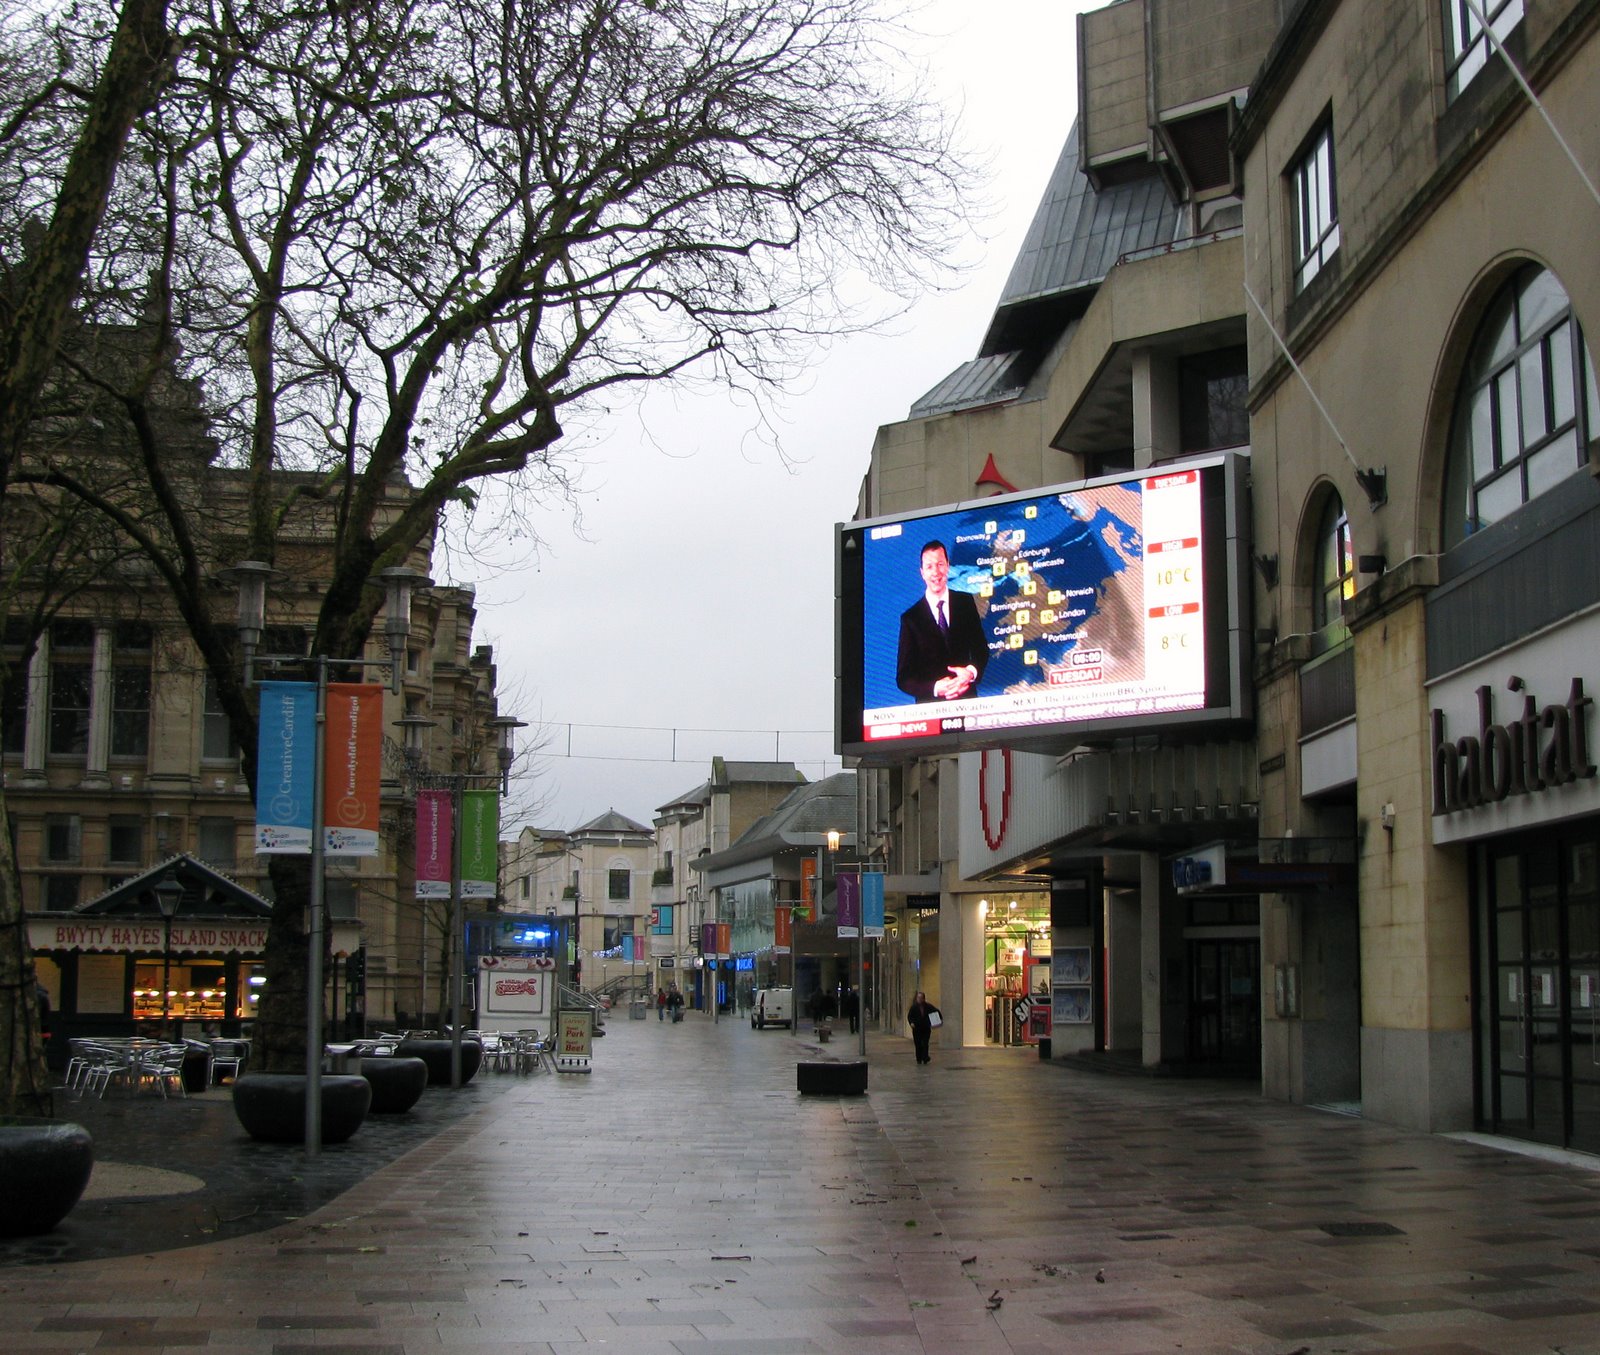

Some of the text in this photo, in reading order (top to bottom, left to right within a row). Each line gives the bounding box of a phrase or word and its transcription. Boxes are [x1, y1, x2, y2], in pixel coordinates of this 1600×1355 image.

[1155, 476, 1188, 488] TUESDAY
[1162, 540, 1183, 551] HIGH
[1018, 547, 1050, 559] Edinburgh
[976, 556, 1003, 566] Glasgow
[1033, 557, 1064, 568] Newcastle
[1066, 587, 1094, 598] Norwich
[990, 600, 1030, 612] Birmingham
[1164, 605, 1184, 616] LOW
[1058, 608, 1086, 618] London
[994, 624, 1016, 635] Cardiff
[1048, 631, 1088, 642] Portsmouth
[988, 640, 1004, 650] outh
[1052, 669, 1100, 683] TUESDAY
[901, 722, 928, 733] NEWS
[1430, 675, 1598, 816] habitat
[56, 925, 108, 944] BWYTY
[112, 926, 160, 945] HAYES
